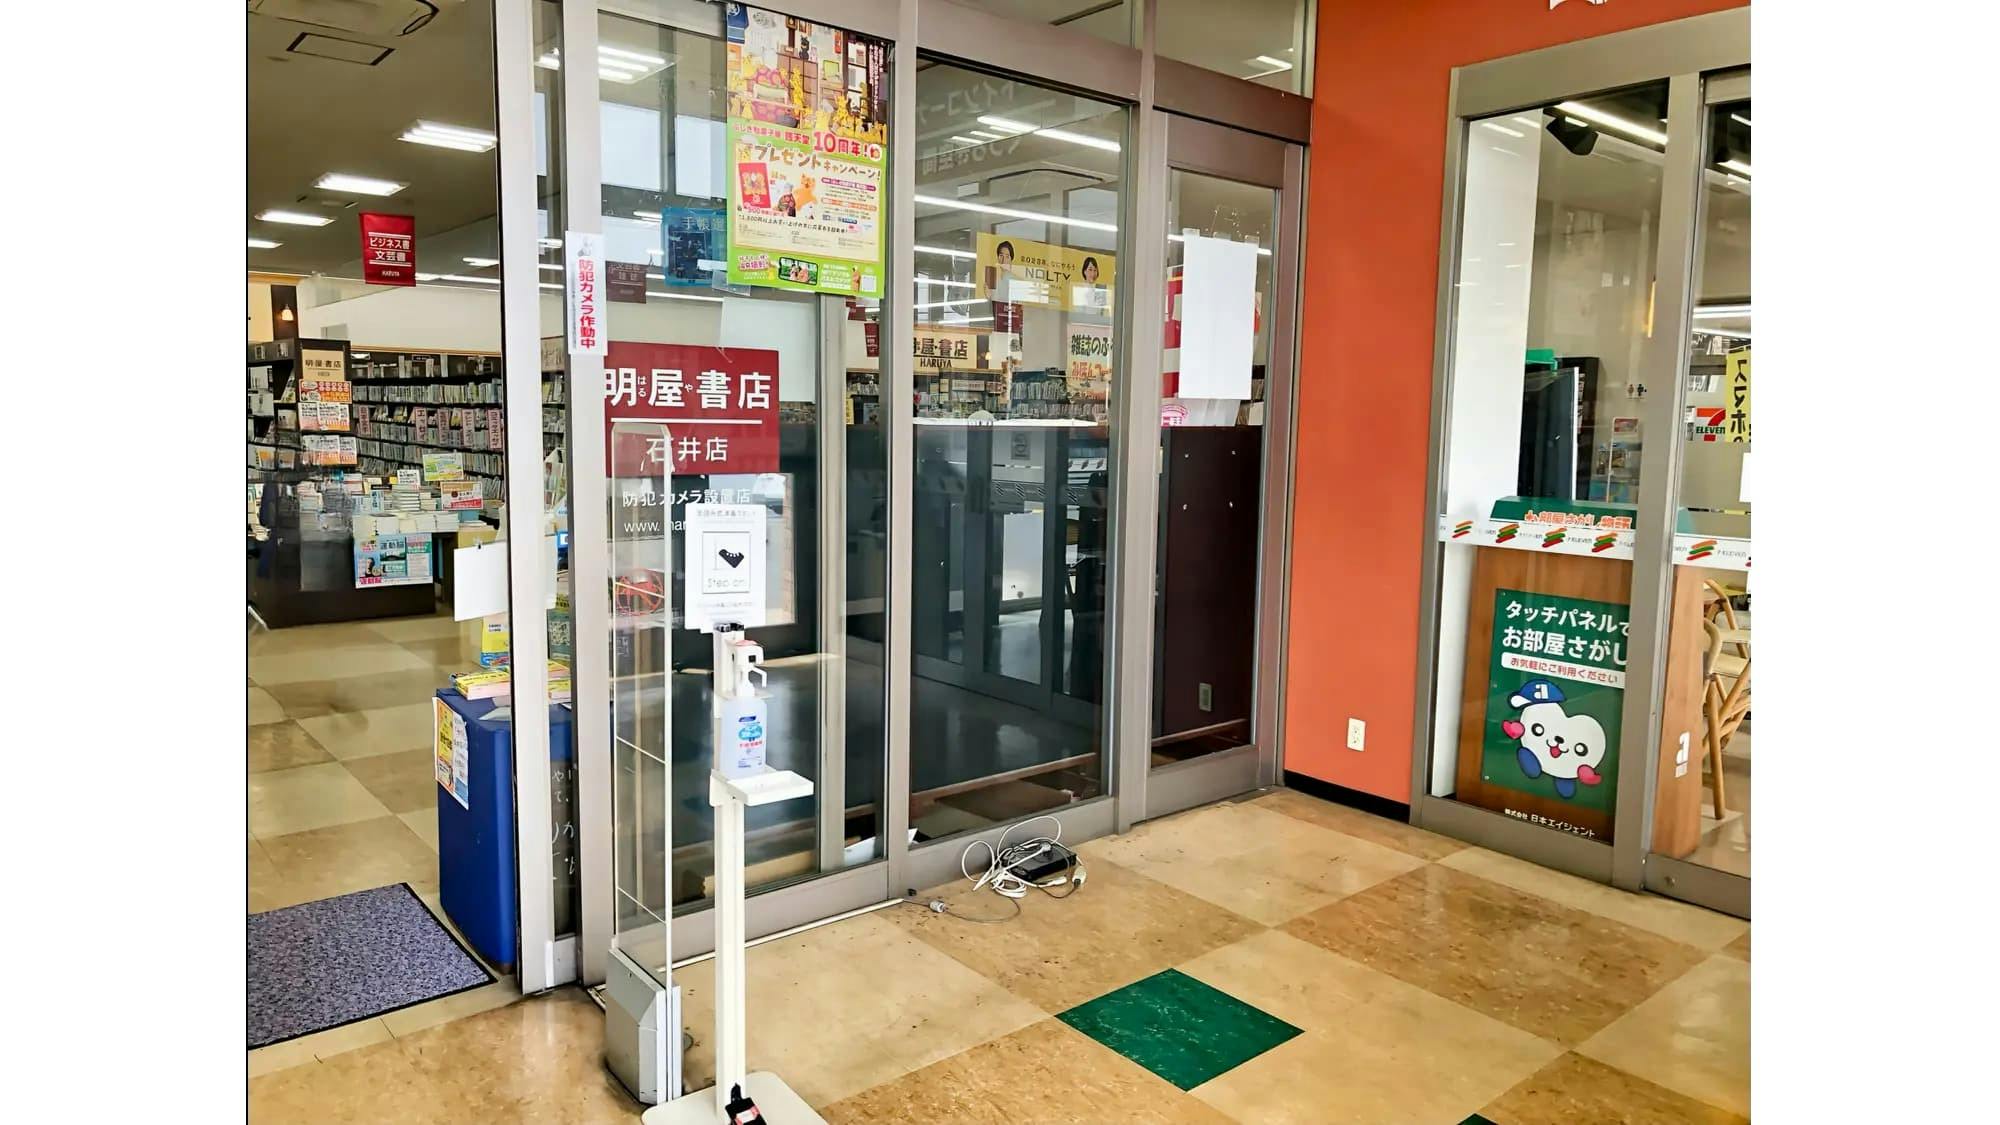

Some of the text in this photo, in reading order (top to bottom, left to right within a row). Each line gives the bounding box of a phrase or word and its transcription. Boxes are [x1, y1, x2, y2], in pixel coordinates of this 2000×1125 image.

[1025, 267, 1071, 282] NOLTY
[578, 259, 596, 349] 防犯カメラ作動中
[920, 357, 952, 368] HARUYA
[646, 436, 729, 463] 石井店
[1510, 657, 1618, 684] お気軽にご利用ください
[1531, 814, 1595, 838] 日本エイジェント
